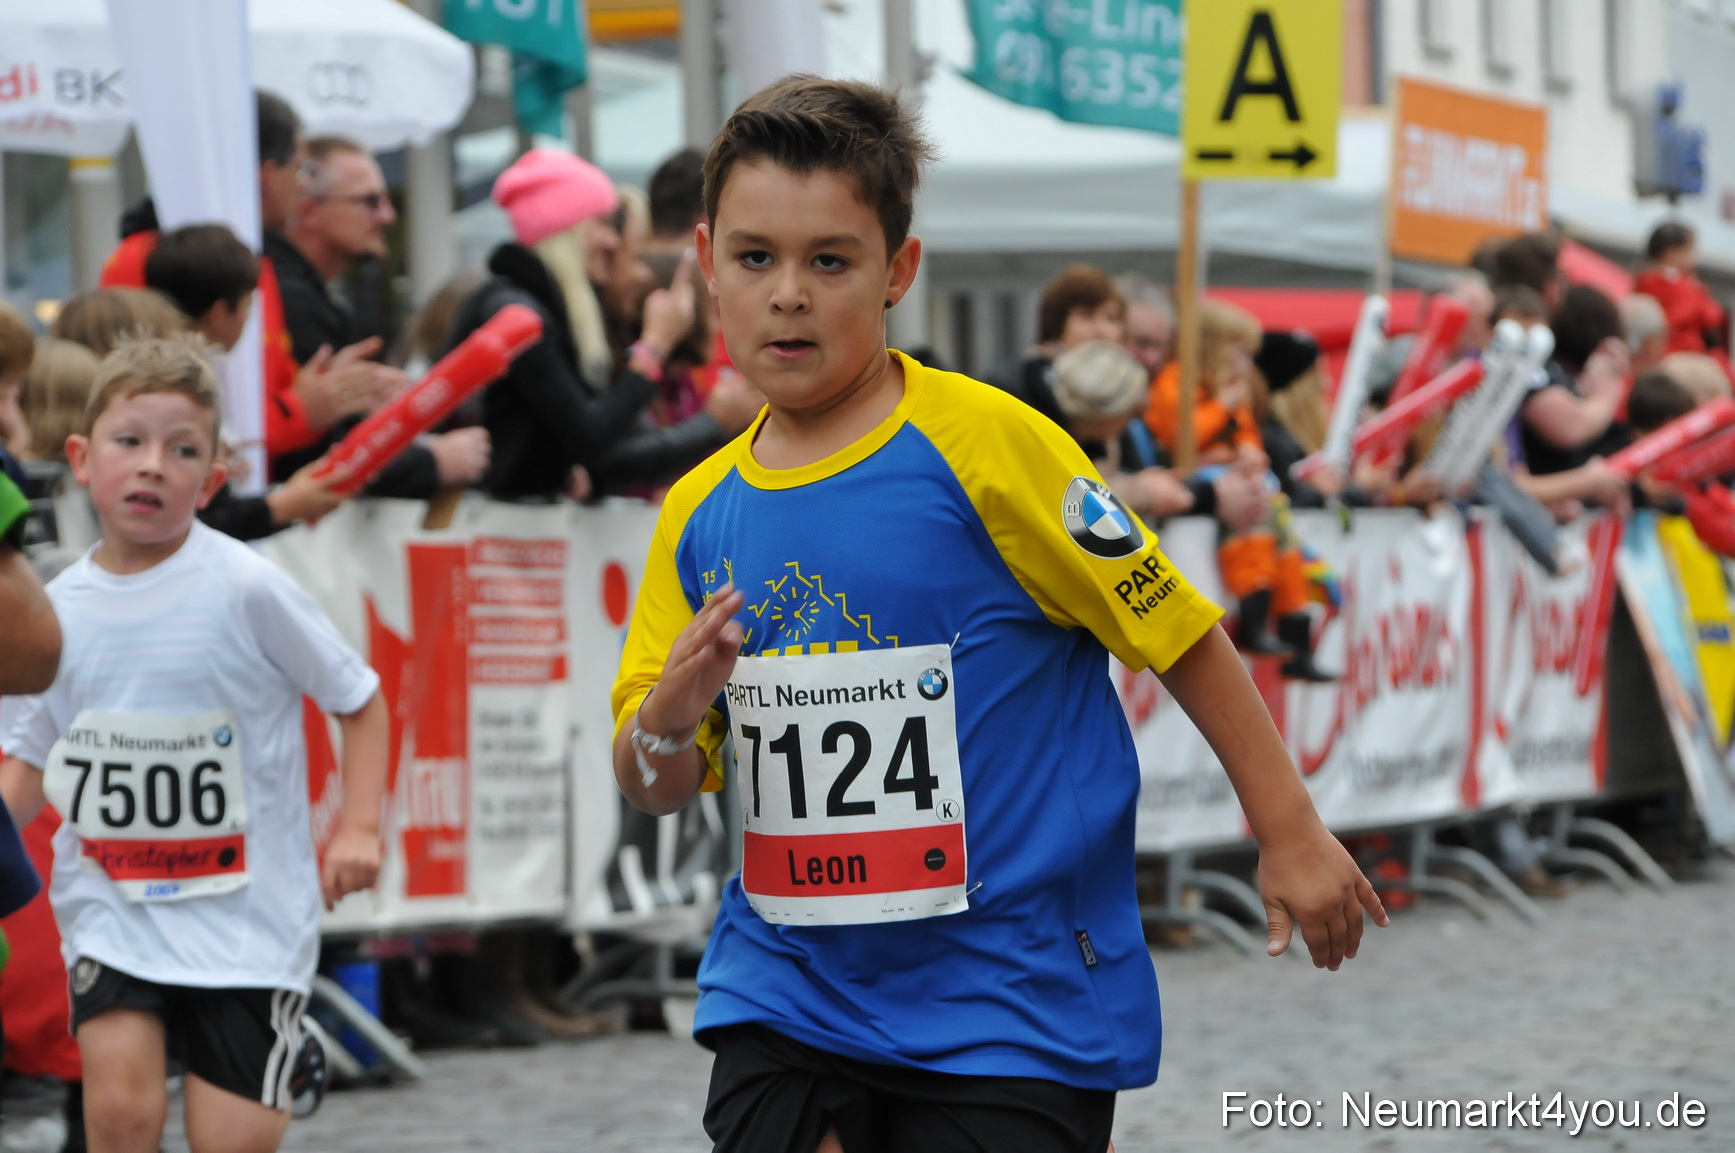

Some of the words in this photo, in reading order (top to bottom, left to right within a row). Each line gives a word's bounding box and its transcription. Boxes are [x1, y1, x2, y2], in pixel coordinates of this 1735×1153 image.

[1219, 11, 1301, 122] A
[727, 682, 771, 708] PARTL
[775, 678, 907, 708] Neumarkt
[109, 733, 205, 752] Neumarkt
[740, 715, 940, 820] 7124
[64, 758, 226, 828] 7506
[942, 802, 952, 818] K
[787, 848, 867, 886] Leon
